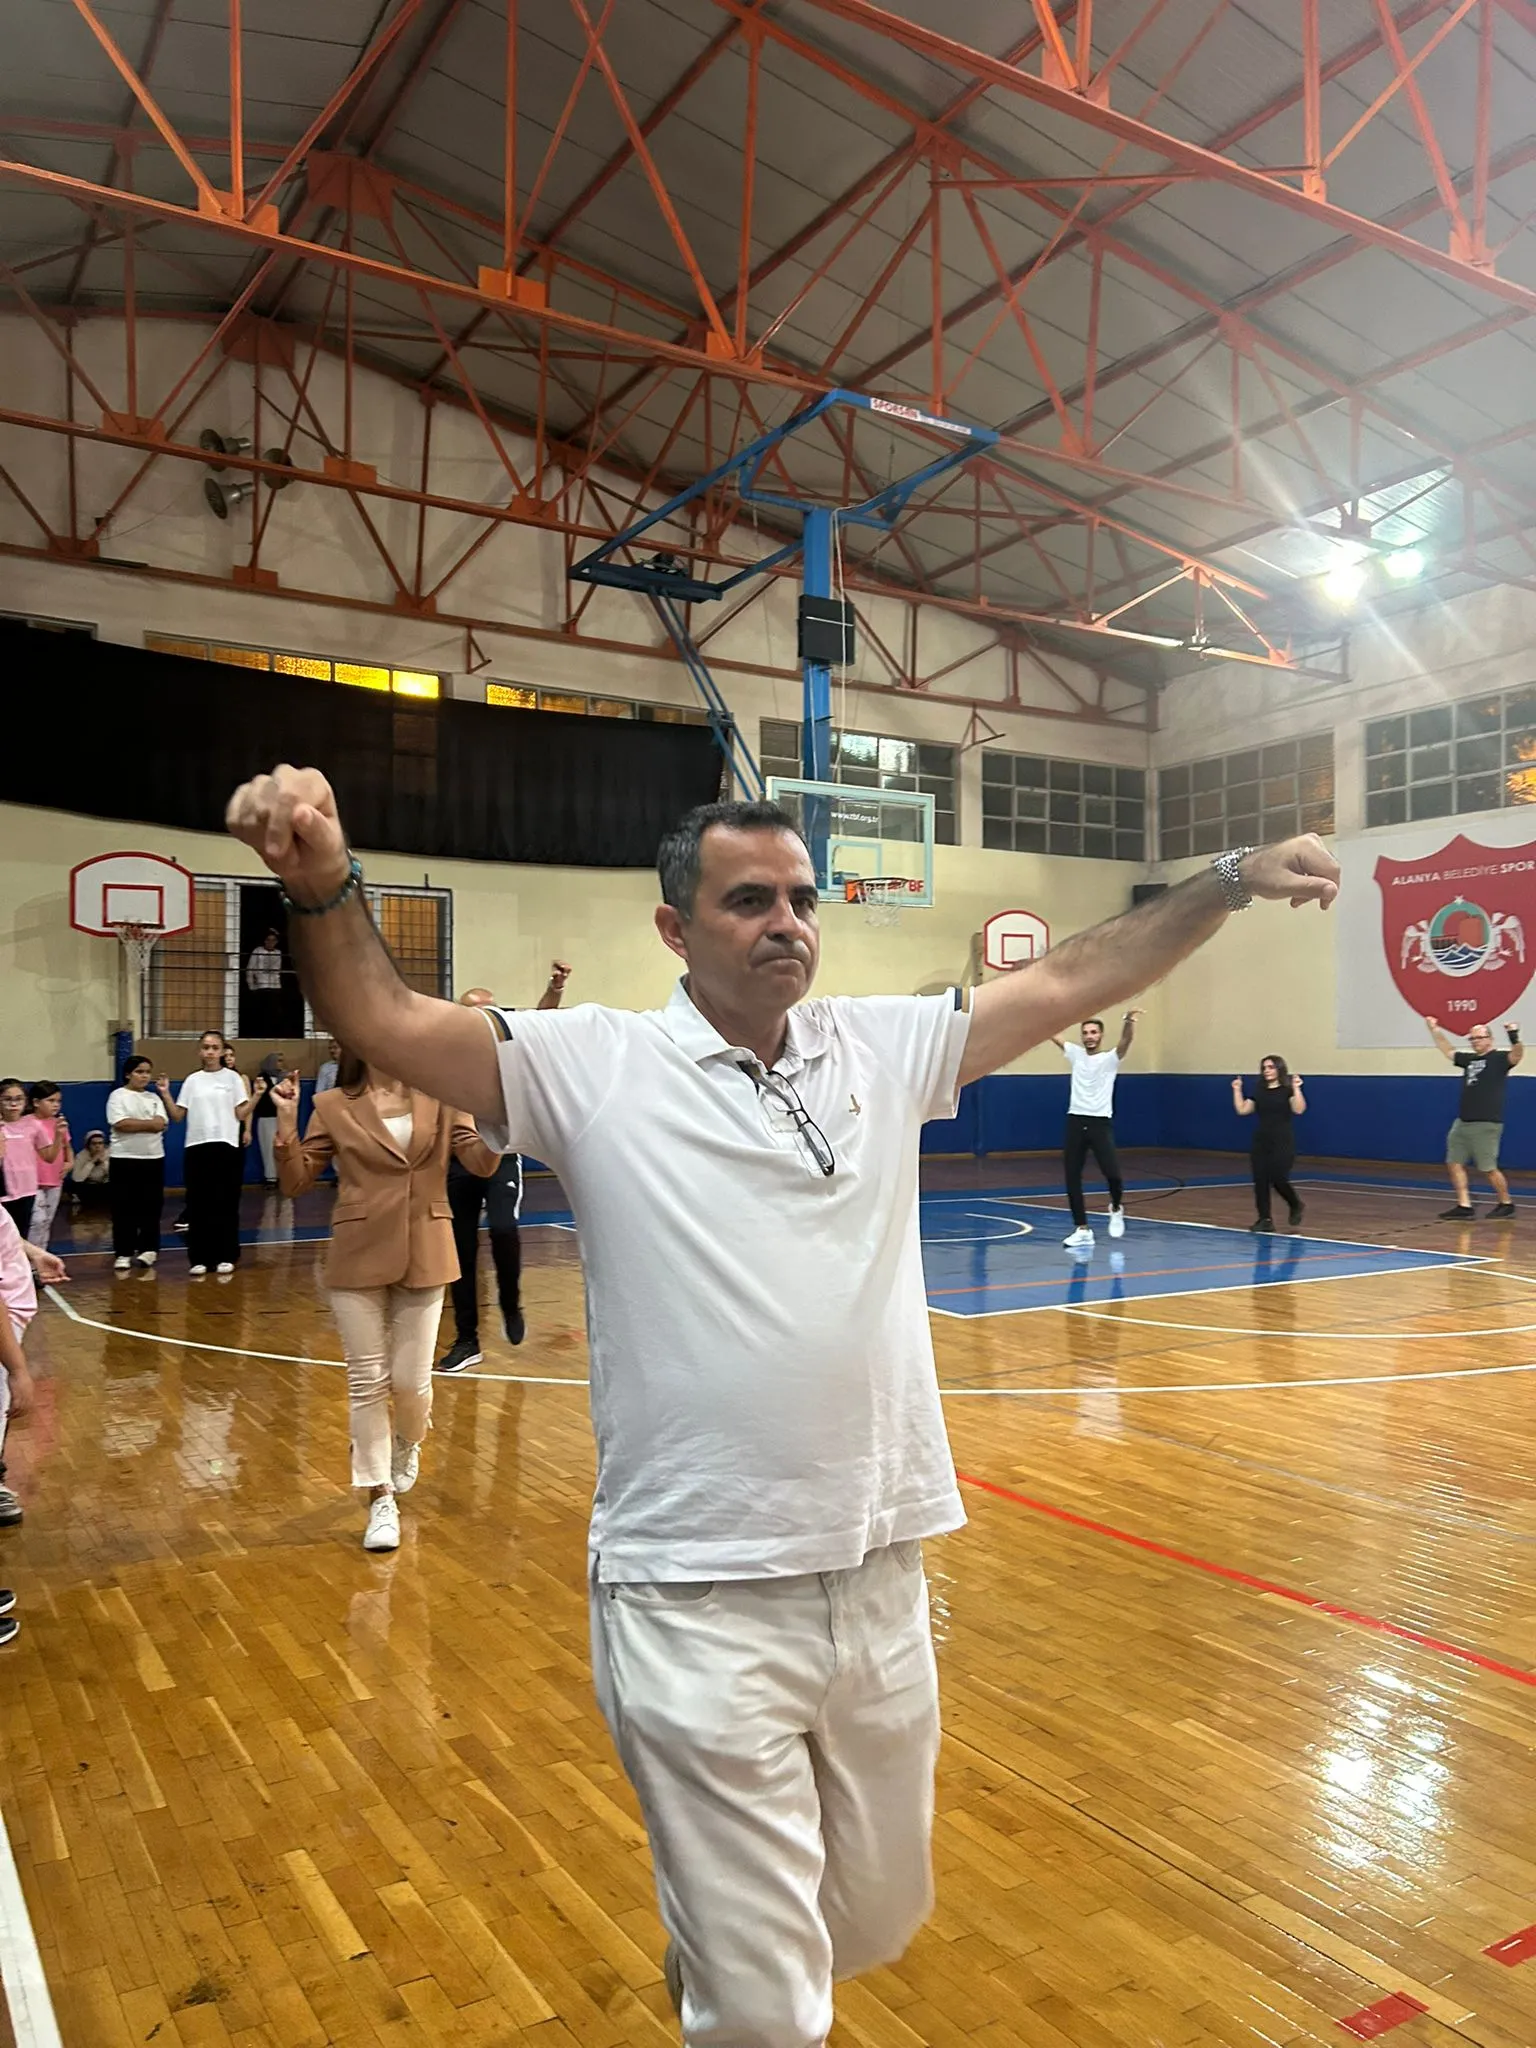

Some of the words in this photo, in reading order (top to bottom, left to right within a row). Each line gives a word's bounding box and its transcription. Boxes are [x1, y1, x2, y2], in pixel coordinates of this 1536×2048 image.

[1391, 871, 1441, 886] ALANYA
[1499, 860, 1535, 874] SPOR
[1447, 999, 1478, 1013] 1990
